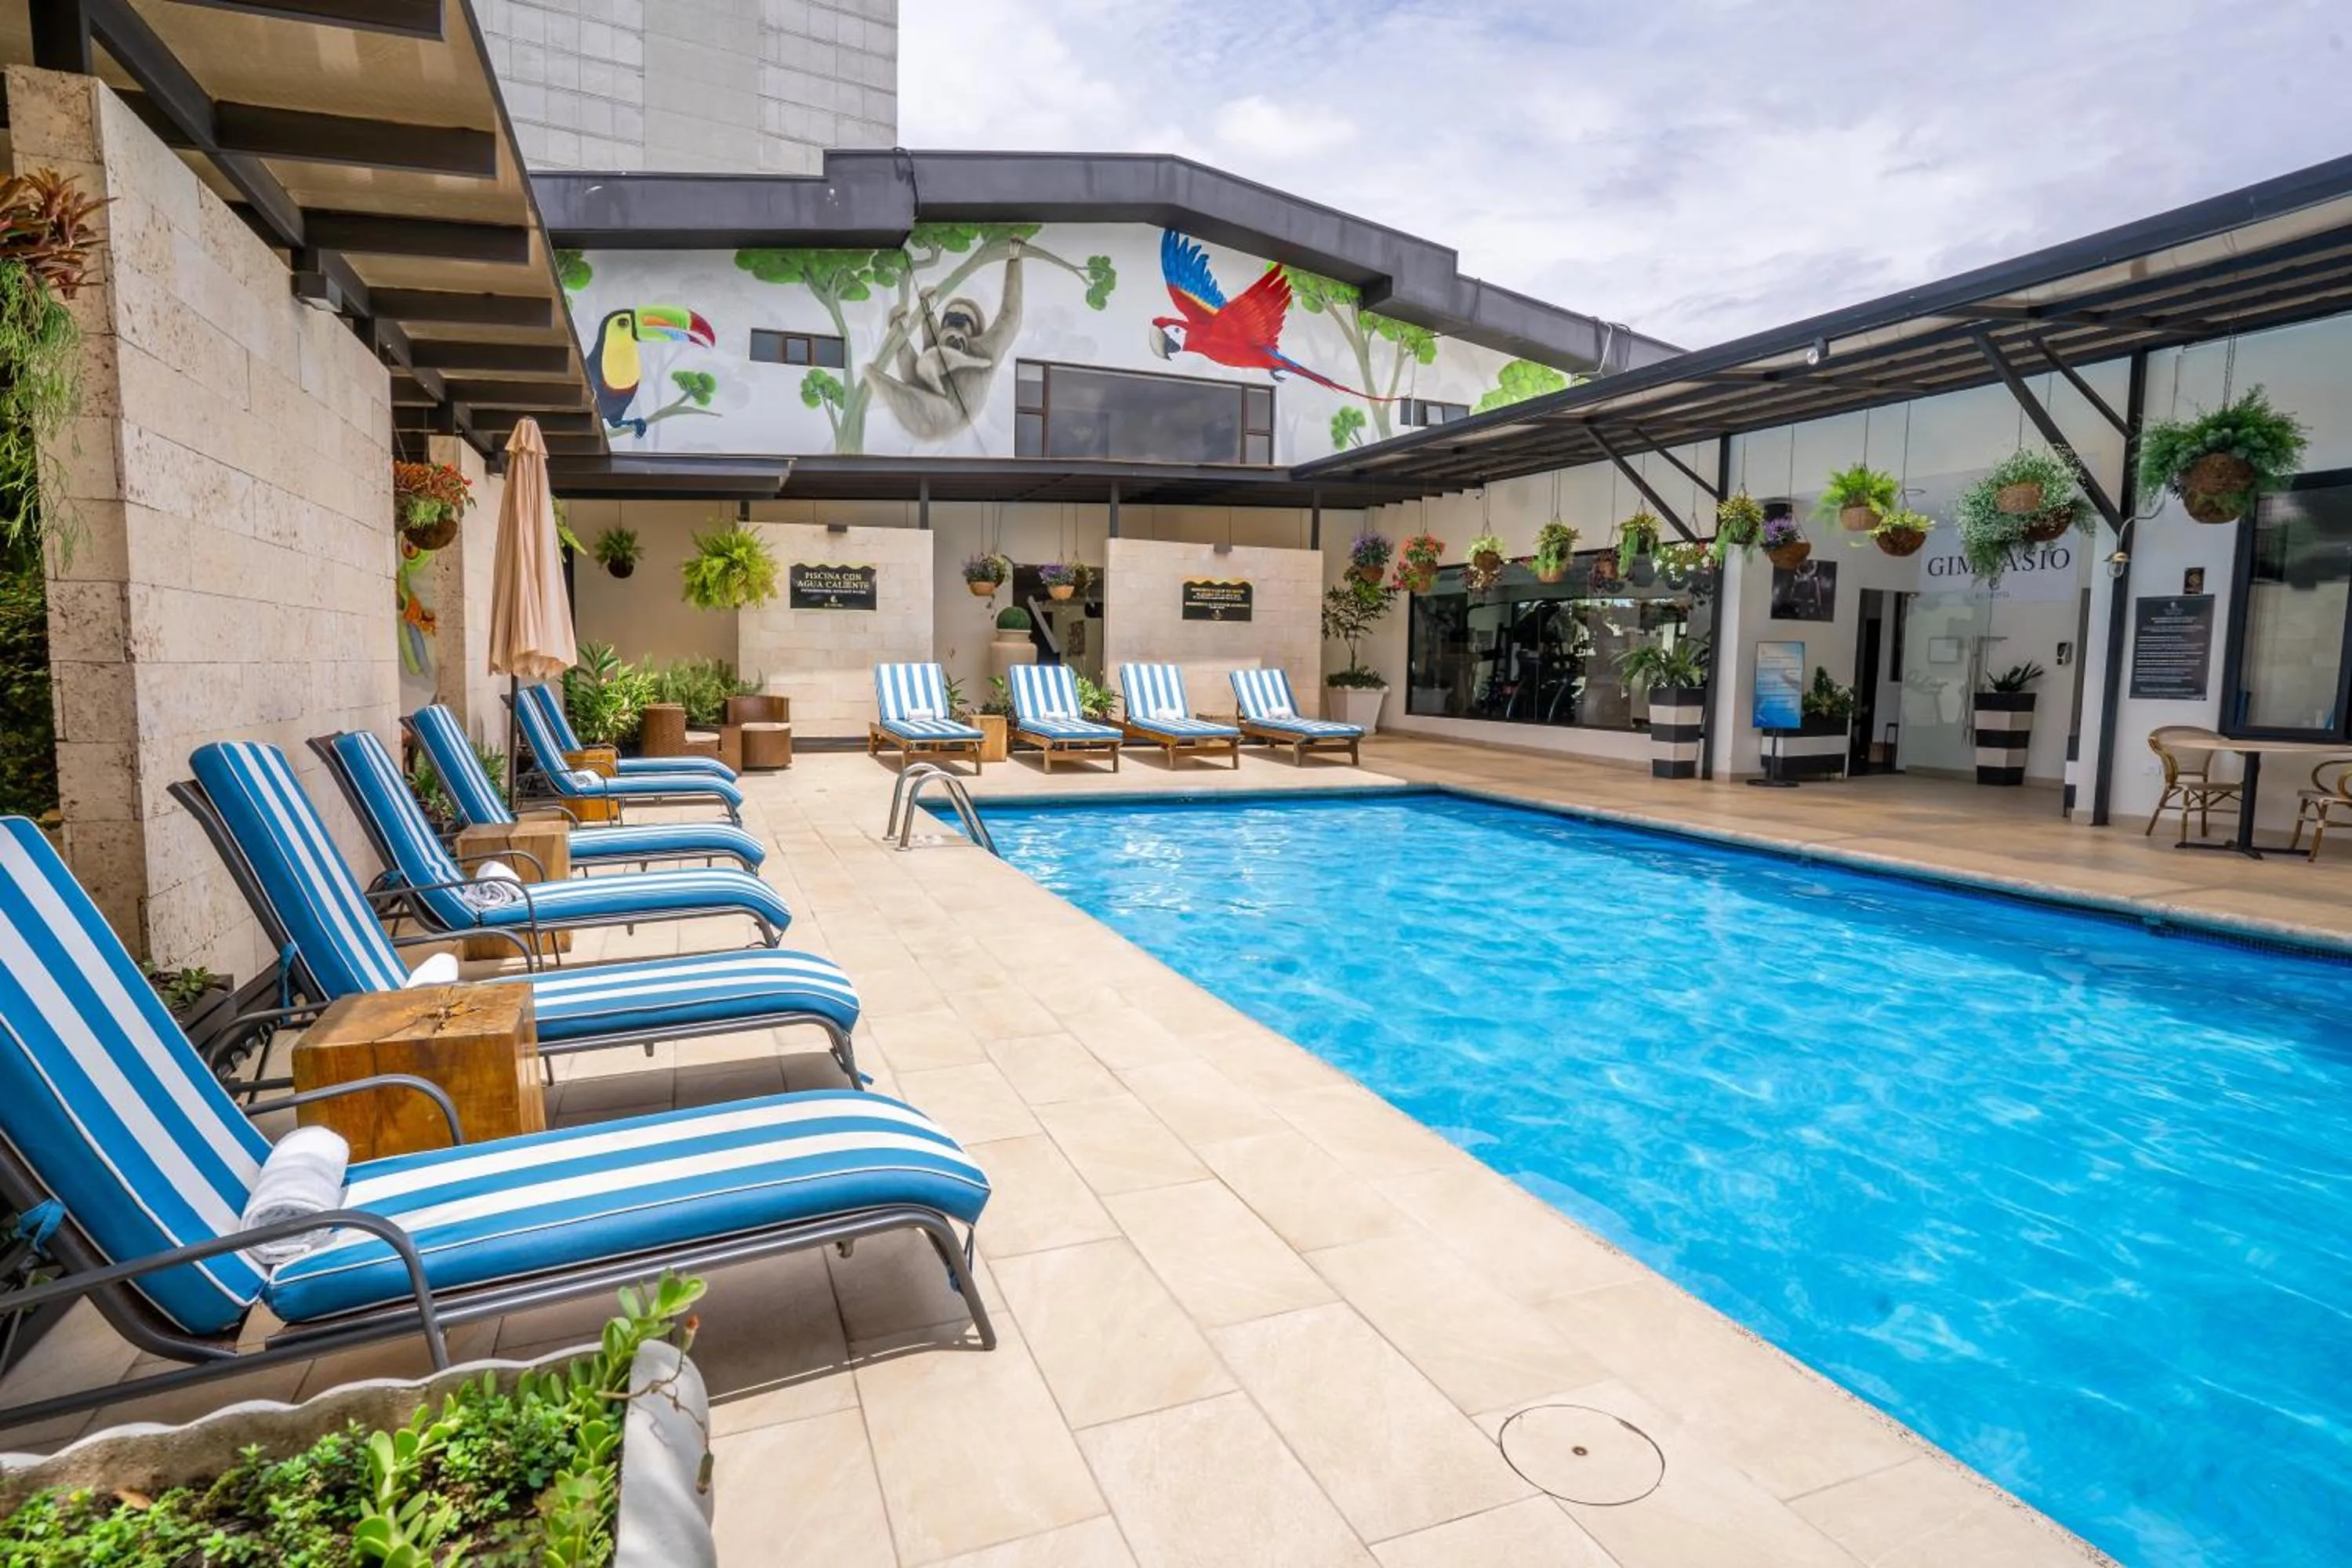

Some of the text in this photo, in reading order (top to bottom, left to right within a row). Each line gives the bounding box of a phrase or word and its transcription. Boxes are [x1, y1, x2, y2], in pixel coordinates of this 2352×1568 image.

[1927, 548, 2071, 577] GIMASIO
[805, 572, 862, 581] PISCINA CON
[797, 579, 869, 589] AGUA CALIENTE
